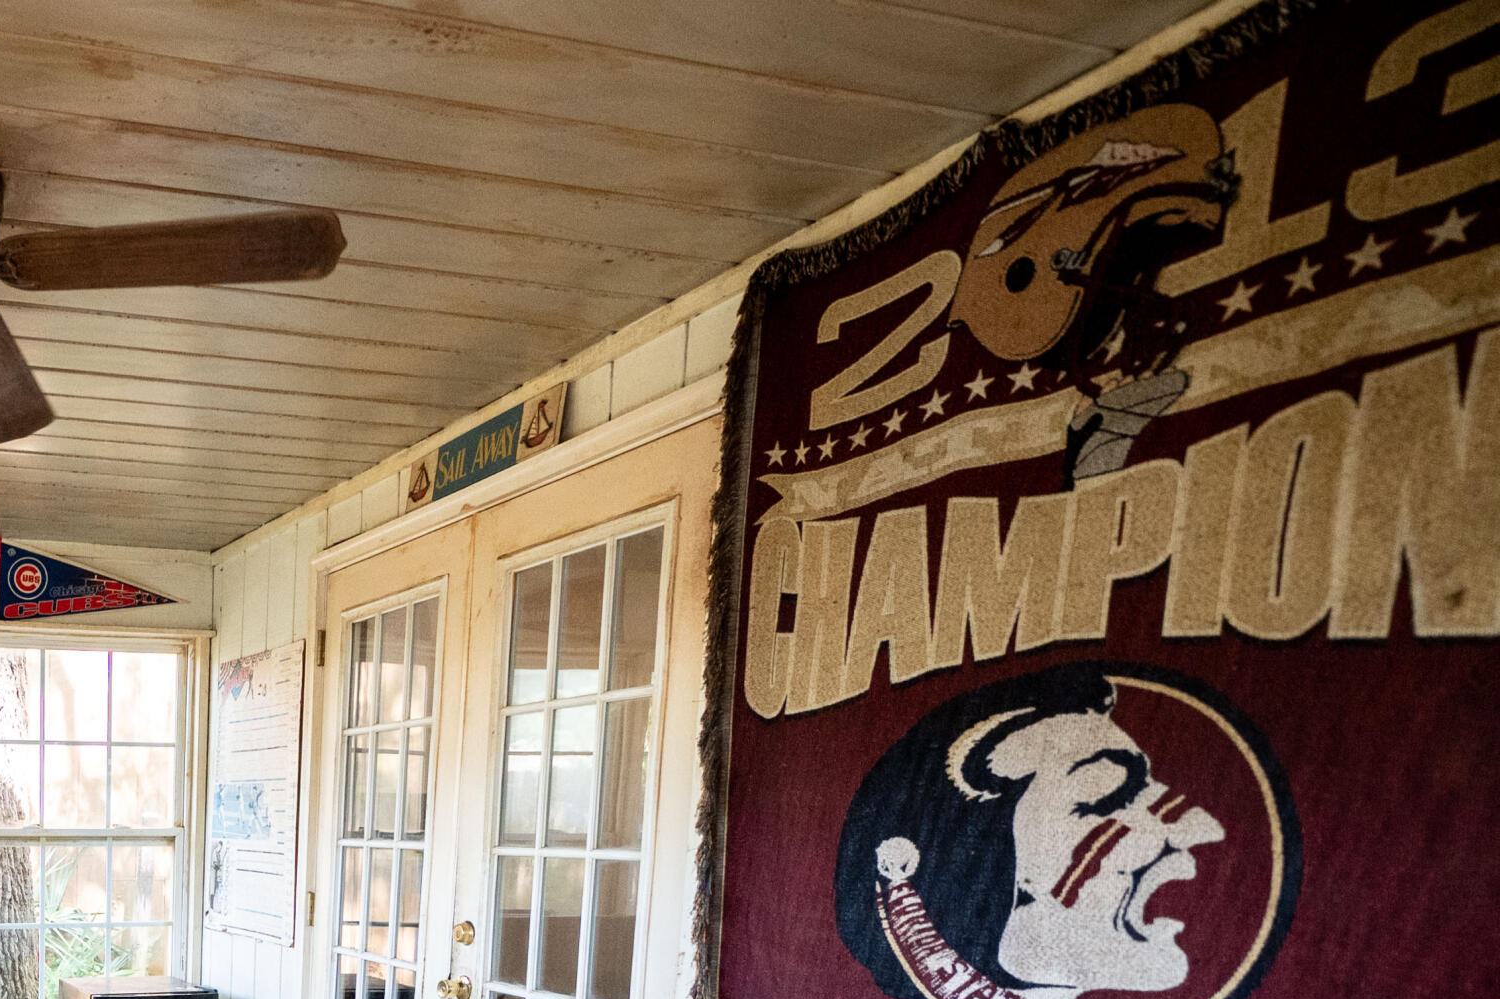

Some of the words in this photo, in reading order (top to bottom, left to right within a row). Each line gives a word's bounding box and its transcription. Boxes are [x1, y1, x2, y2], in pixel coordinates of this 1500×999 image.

[811, 0, 1500, 432] 213
[436, 448, 467, 489] SAIL
[471, 421, 518, 473] AWAY
[4, 592, 136, 619] CUBS
